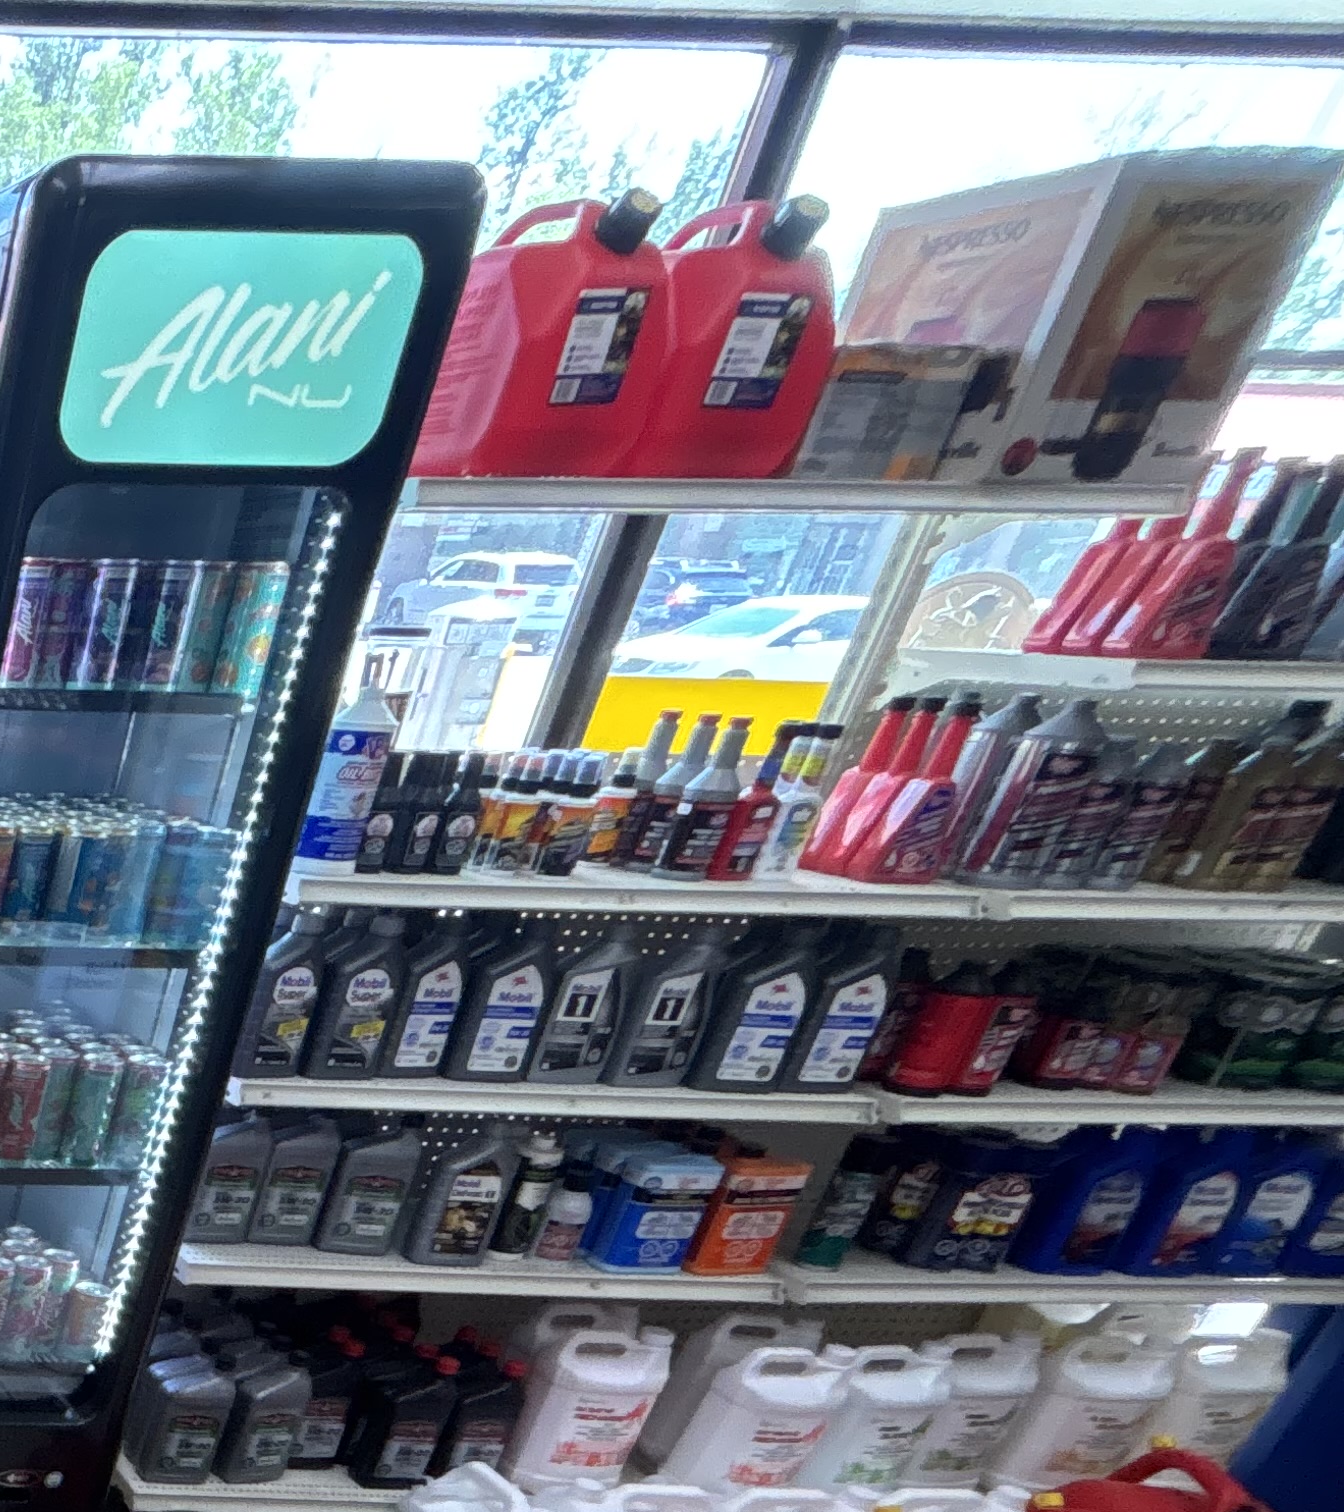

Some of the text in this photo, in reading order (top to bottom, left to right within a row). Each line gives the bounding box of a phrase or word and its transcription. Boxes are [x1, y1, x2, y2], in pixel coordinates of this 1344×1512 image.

[100, 269, 393, 429] Alani
[247, 383, 353, 409] NU
[279, 975, 312, 988] Mobil
[353, 976, 387, 989] Mobil
[423, 987, 454, 999] Mobil
[499, 991, 535, 1004] Mobil
[755, 1000, 794, 1012] Mobil
